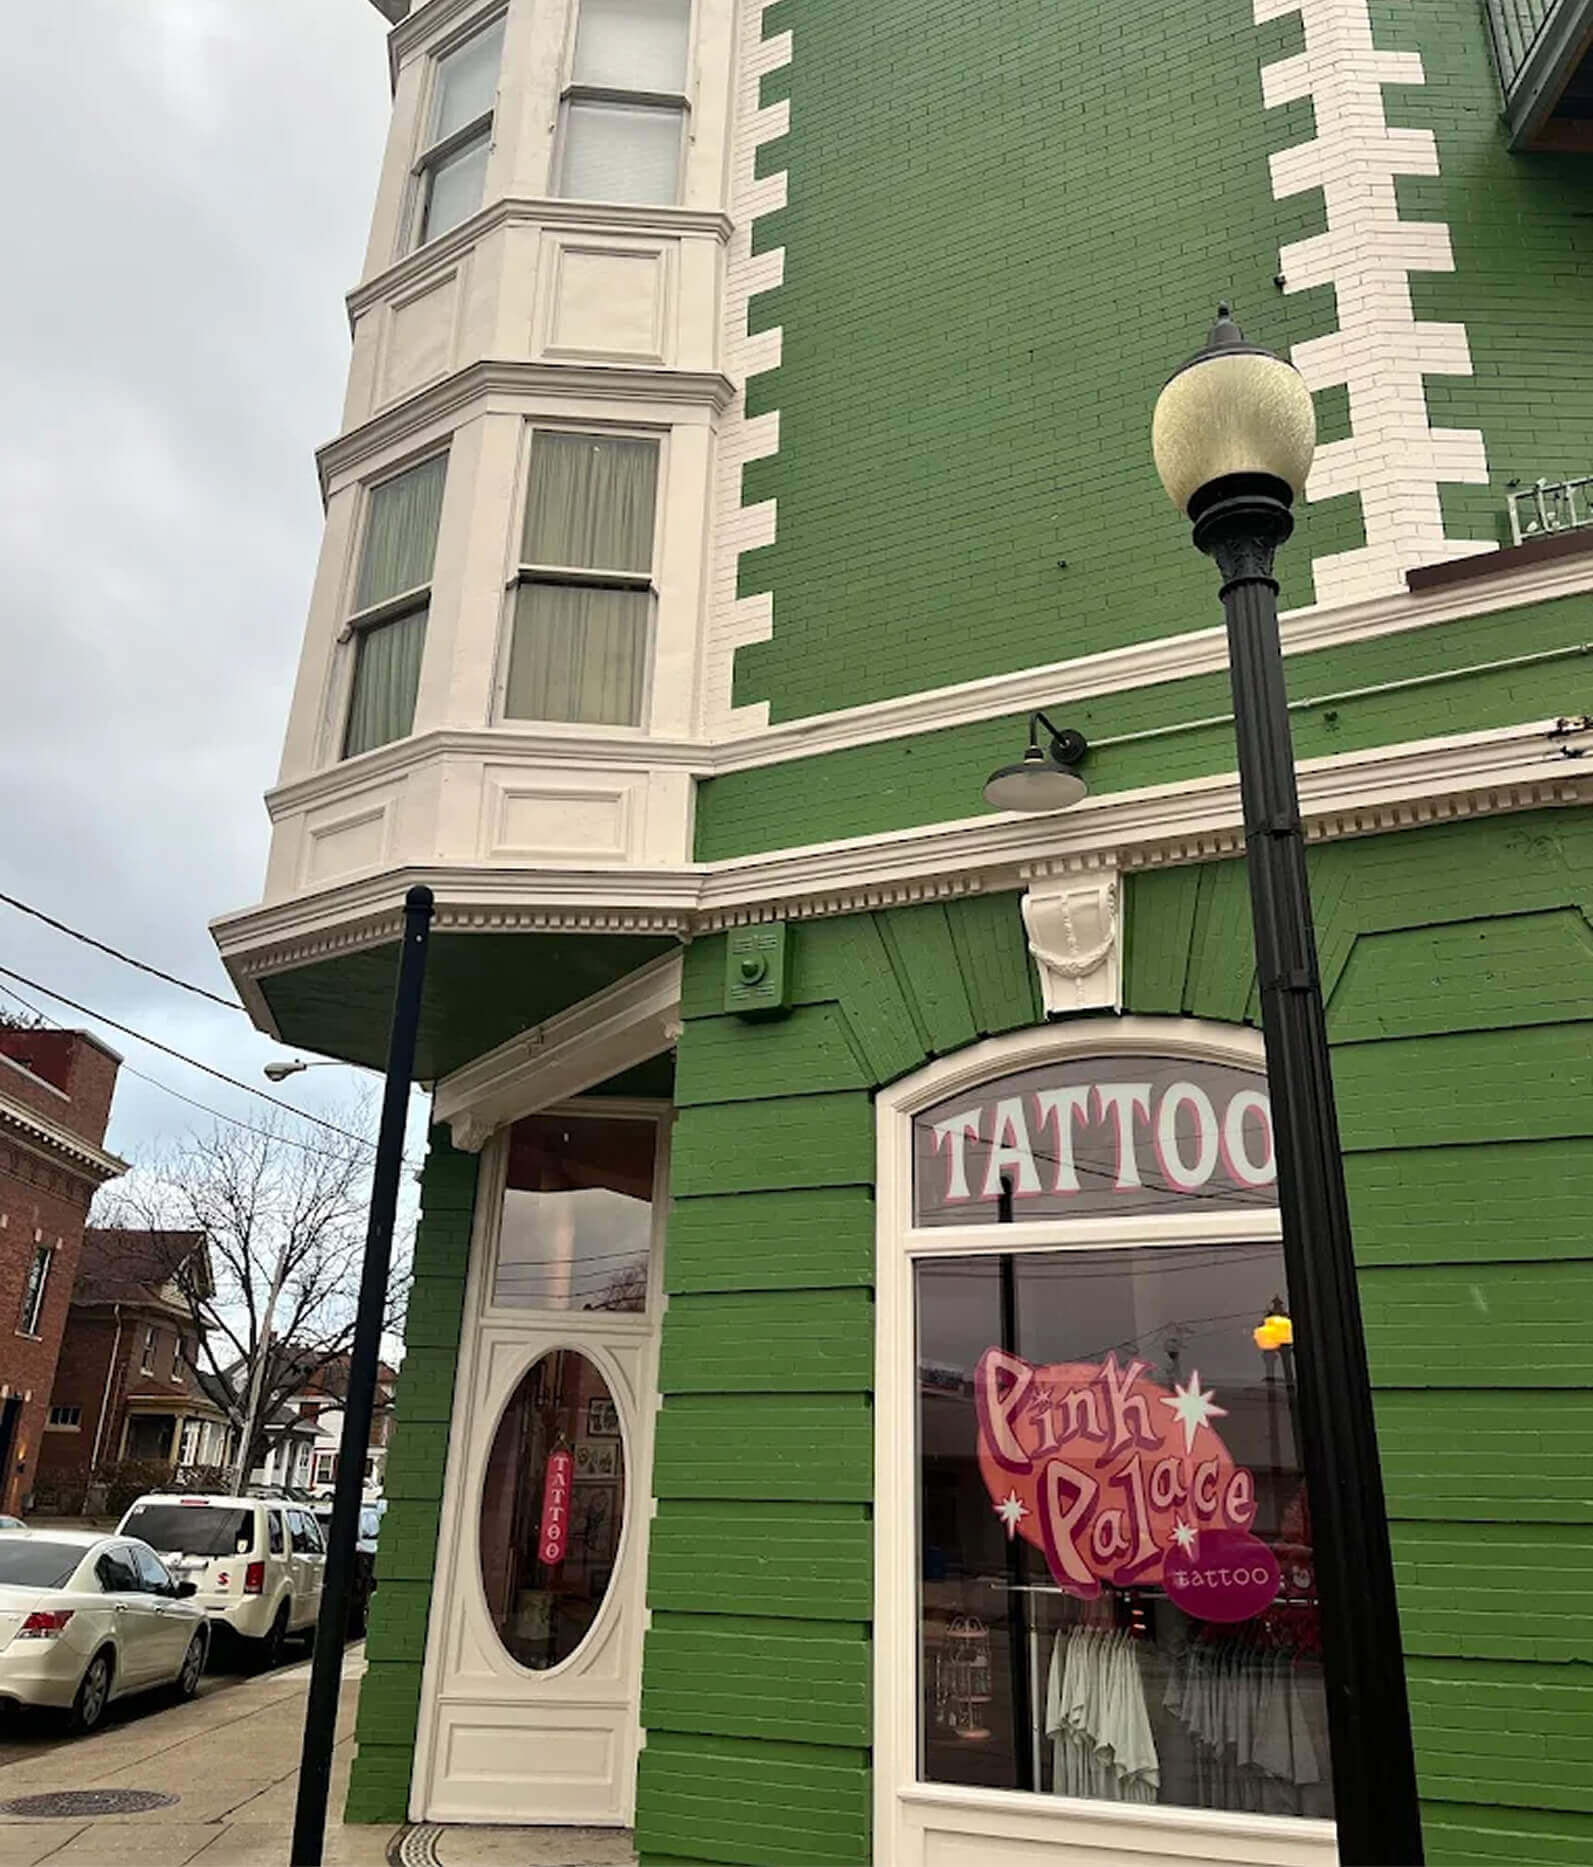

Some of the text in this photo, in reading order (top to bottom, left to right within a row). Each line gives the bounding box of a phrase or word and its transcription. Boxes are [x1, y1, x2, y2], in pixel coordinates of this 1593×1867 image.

[932, 1082, 1277, 1201] TATTOO
[545, 1456, 568, 1559] TATTOO
[1037, 1453, 1254, 1597] Palace
[1174, 1567, 1269, 1588] tattoo
